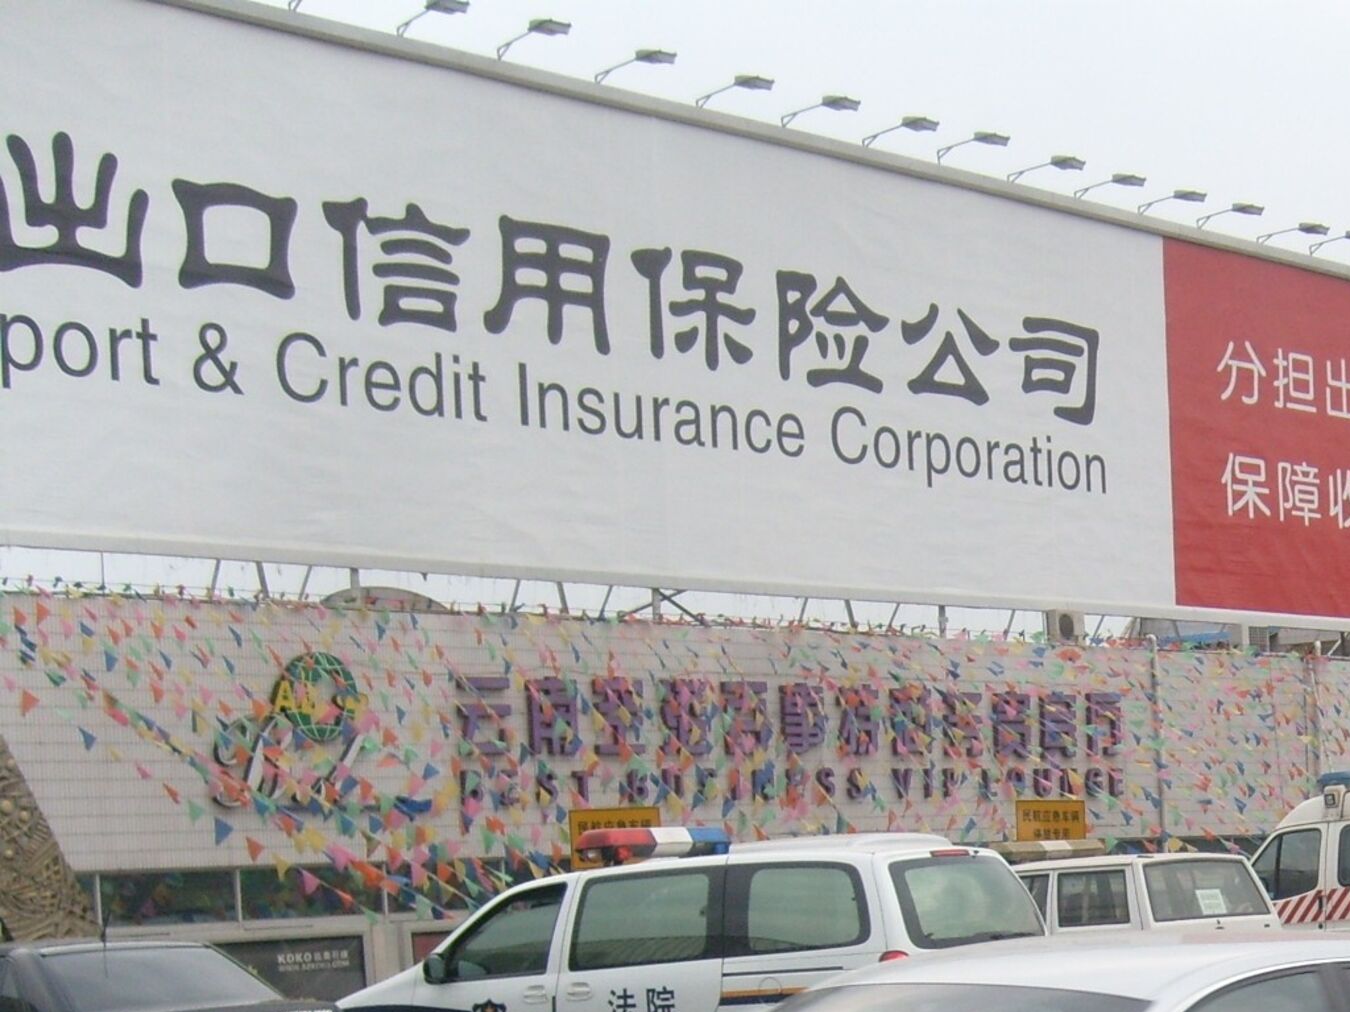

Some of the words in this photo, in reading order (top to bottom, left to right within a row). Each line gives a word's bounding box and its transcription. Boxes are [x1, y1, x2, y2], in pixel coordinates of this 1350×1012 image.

[0, 131, 1099, 426] 出口信用保险公司
[0, 313, 160, 389] port
[193, 322, 244, 395] &
[276, 332, 488, 422] Credit
[518, 362, 805, 458] Insurance
[831, 406, 1107, 494] Corporation
